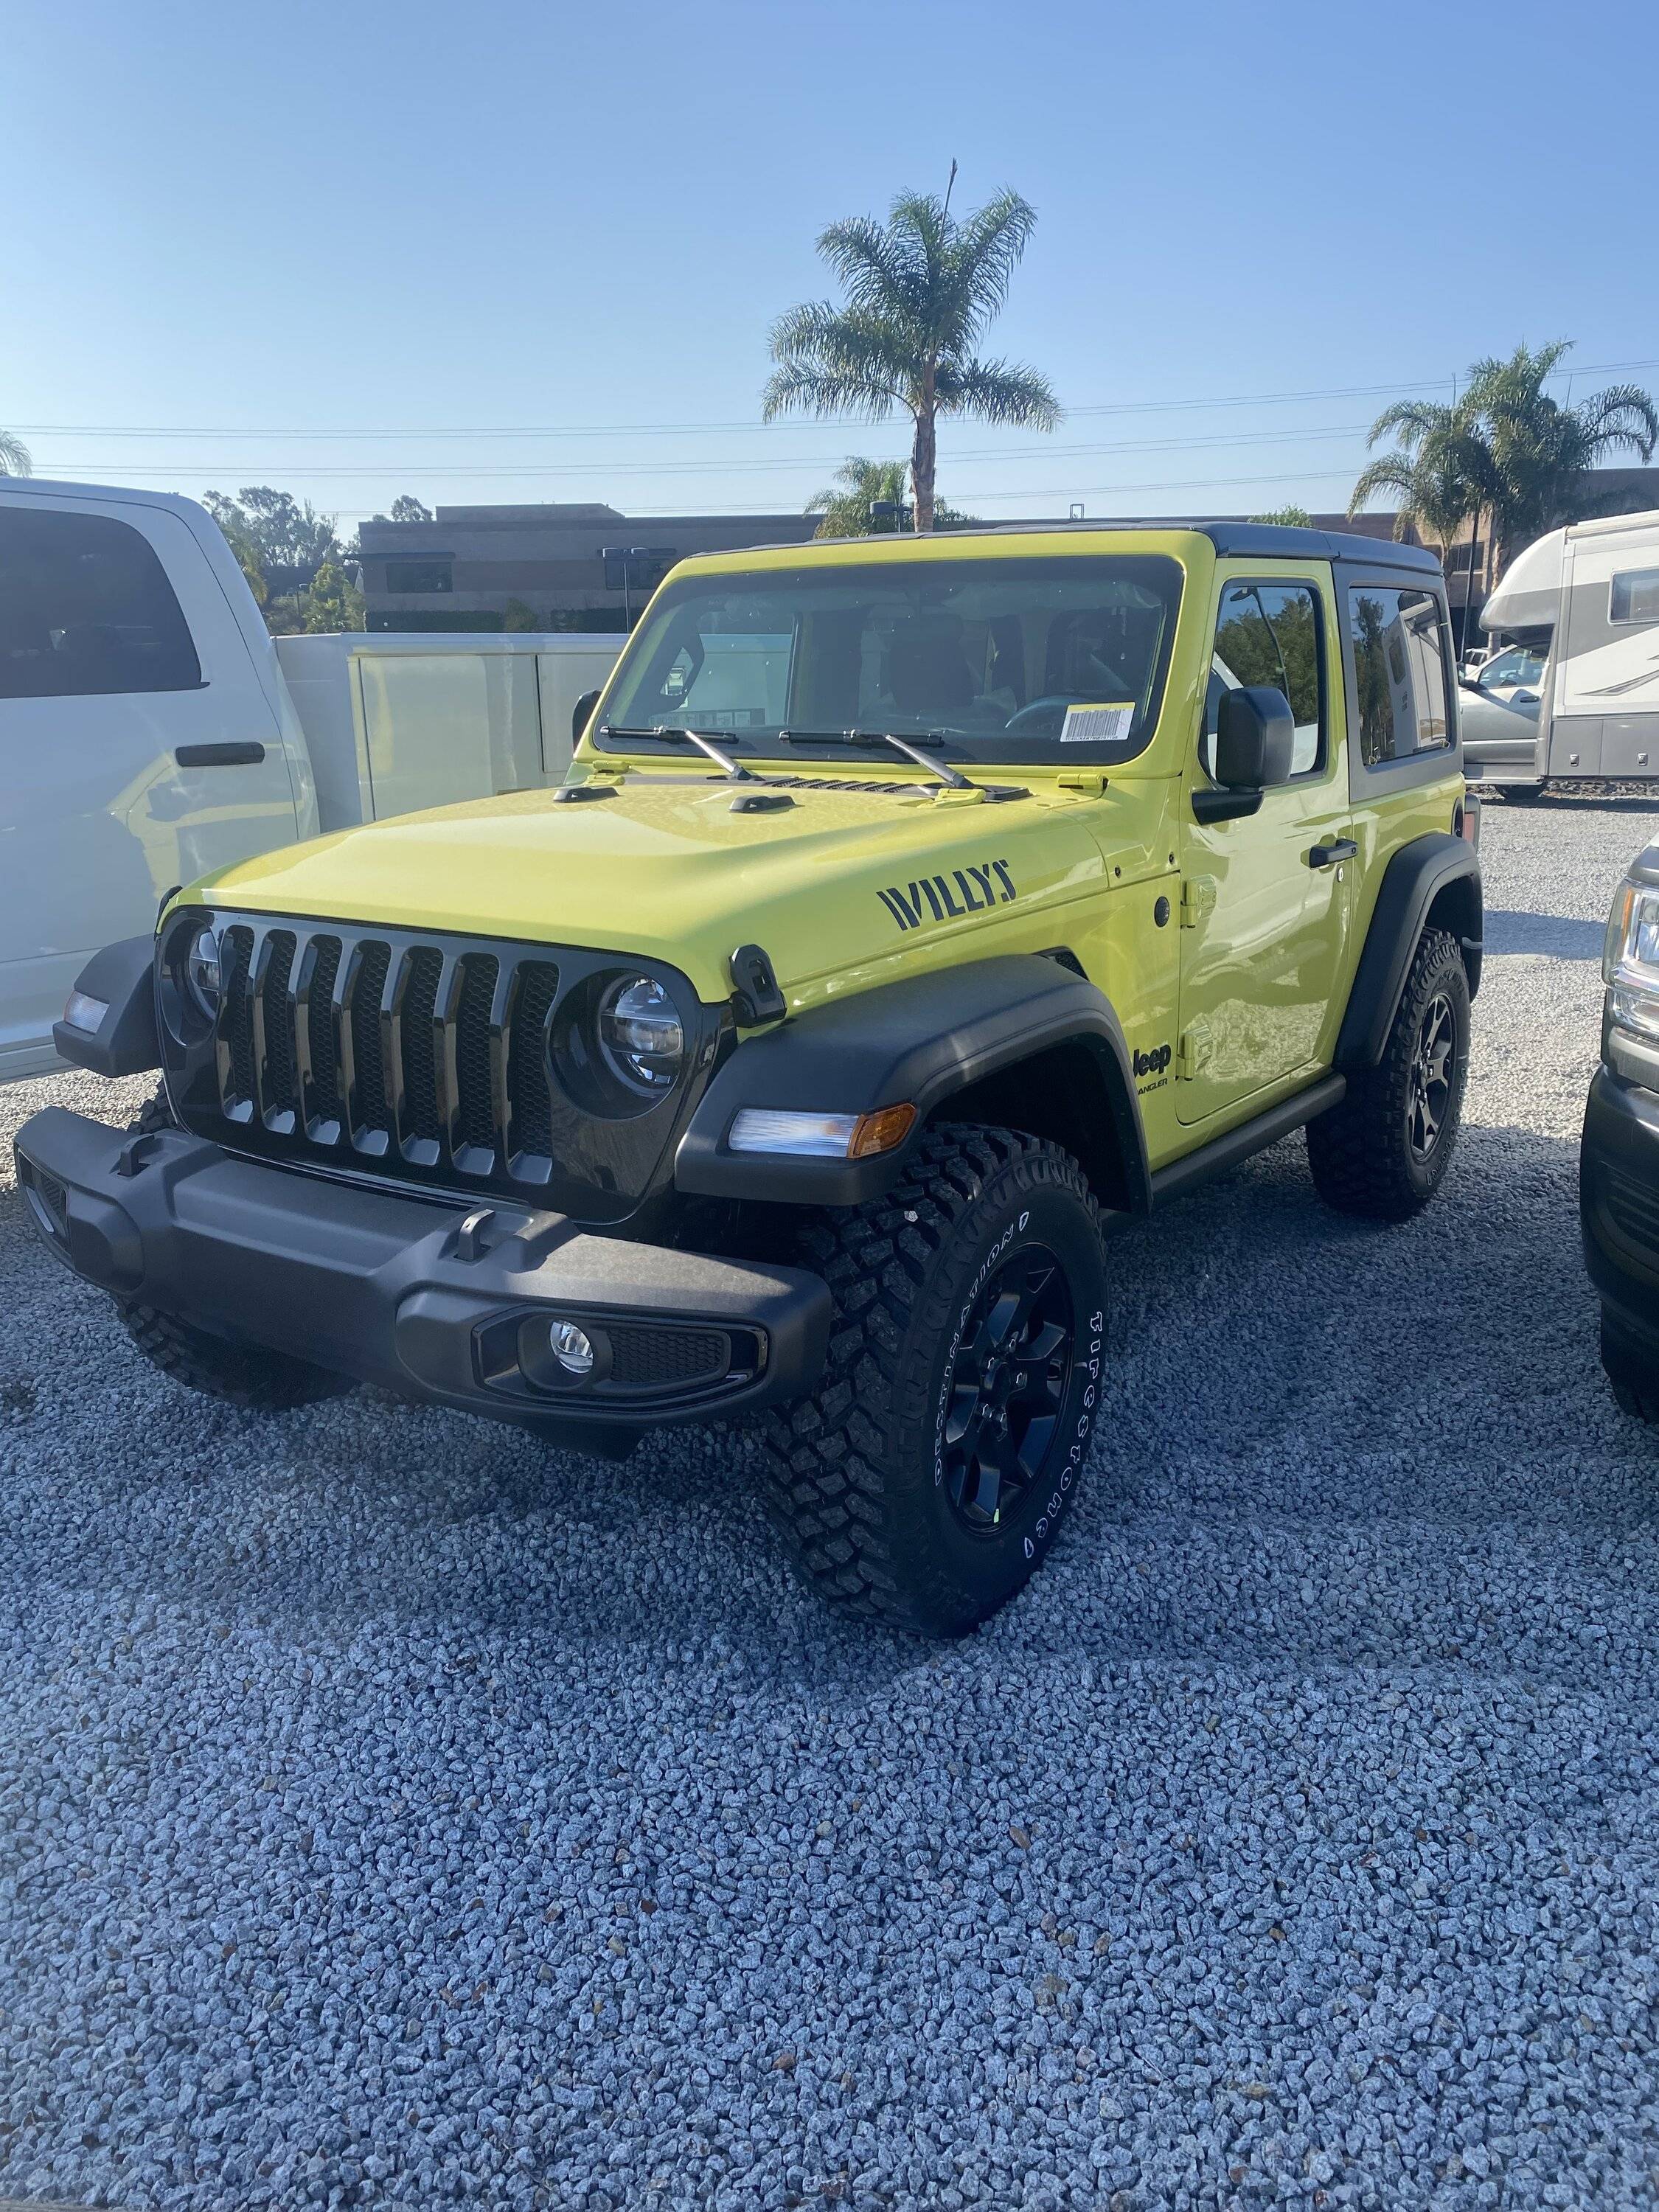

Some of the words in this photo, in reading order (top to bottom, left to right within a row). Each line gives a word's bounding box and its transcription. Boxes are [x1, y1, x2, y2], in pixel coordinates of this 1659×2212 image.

[876, 859, 1017, 931] WILLYS
[1138, 1077, 1168, 1096] ANGLER
[1035, 1311, 1103, 1539] Firestone
